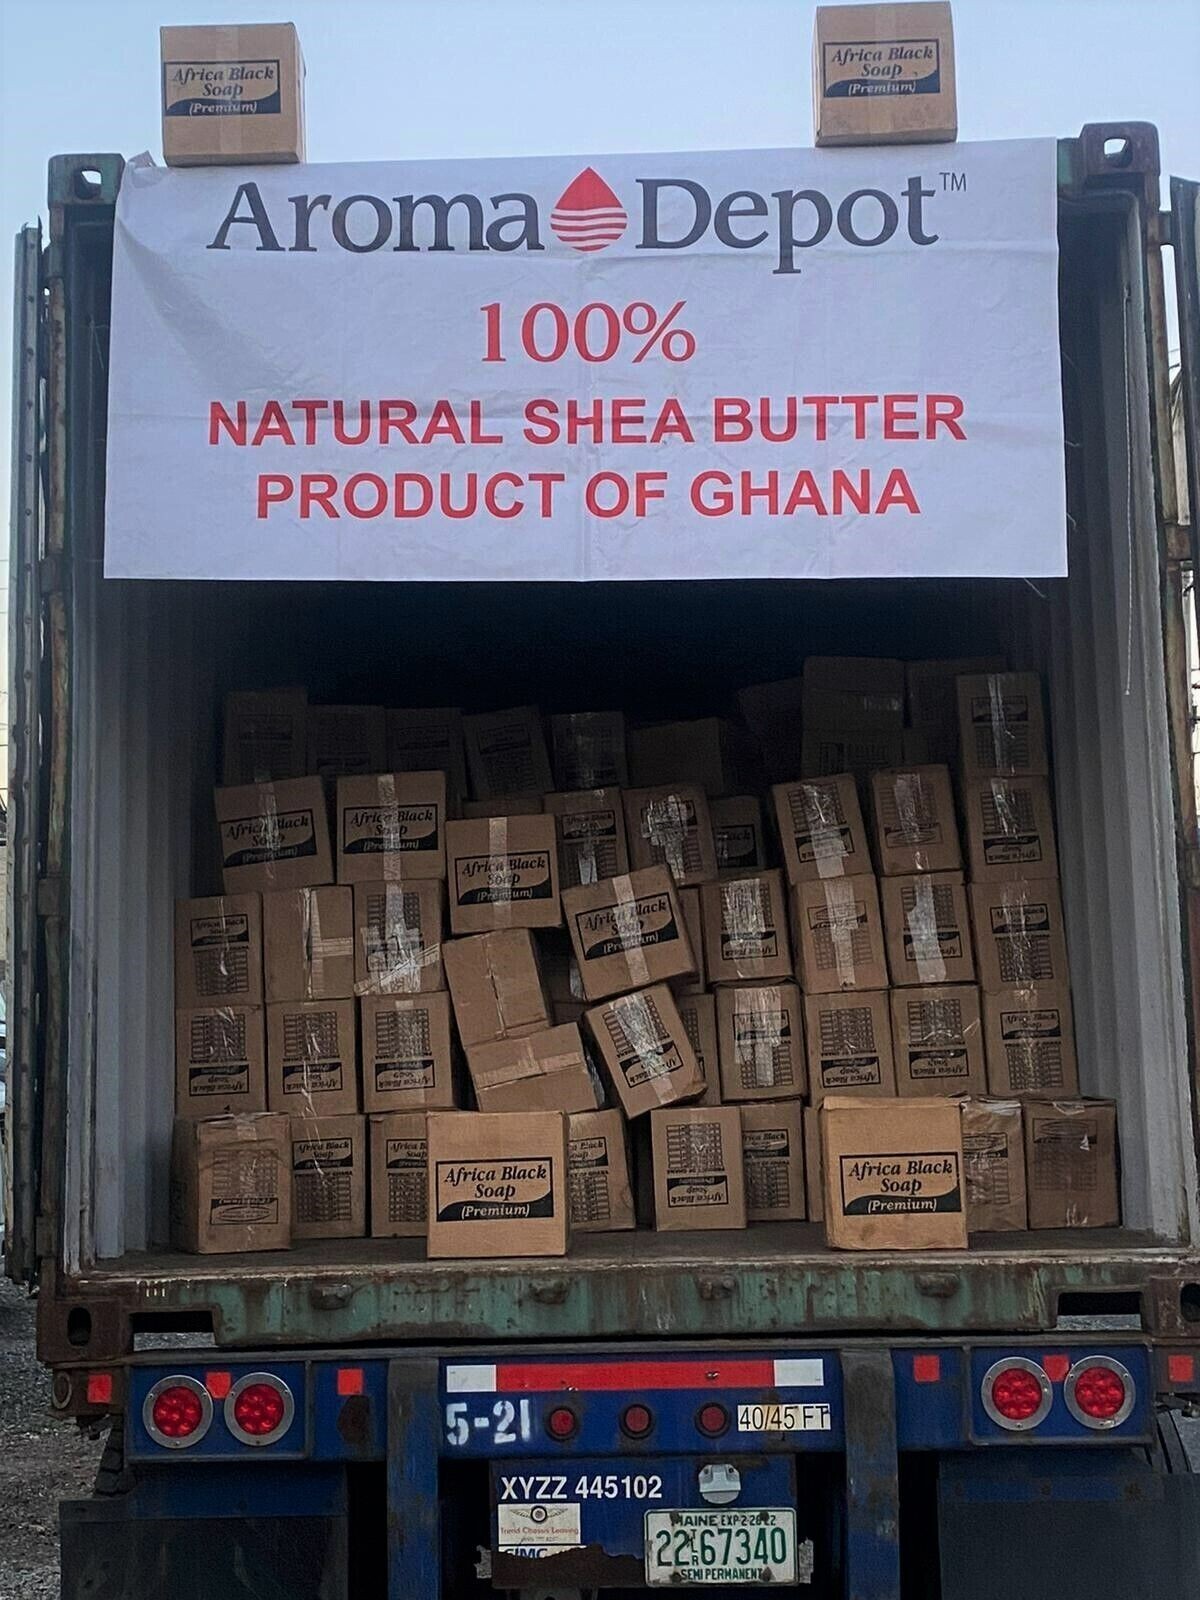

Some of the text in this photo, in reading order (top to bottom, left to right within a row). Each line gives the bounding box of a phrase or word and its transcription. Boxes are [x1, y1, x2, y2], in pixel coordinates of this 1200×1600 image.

[832, 46, 934, 66] Africa Black
[174, 66, 274, 85] Africa Black
[860, 63, 902, 79] Soap
[202, 83, 243, 98] Soap
[847, 81, 917, 96] (Premium)
[189, 101, 258, 114] (Premium)
[206, 171, 967, 274] Aroma Depot TM
[480, 300, 696, 363] 100%
[208, 394, 967, 446] NATURAL SHEA BUTTER
[257, 469, 921, 519] PRODUCT OF GHANA
[398, 810, 433, 822] Black
[509, 857, 545, 870] Black
[763, 1131, 786, 1139] Black
[325, 1140, 349, 1149] Black
[445, 1164, 547, 1187] Africa Black
[849, 1160, 952, 1181] Africa Black
[475, 1184, 516, 1201] Soap
[881, 1178, 922, 1195] Soap
[671, 1196, 695, 1204] Black
[868, 1198, 937, 1214] (Premium)
[461, 1204, 530, 1220] (Premium)
[446, 1399, 530, 1446] 5-21
[739, 1405, 829, 1431] 40/45 FT
[501, 1475, 662, 1500] XYZZ 445102
[656, 1529, 690, 1567] 22
[700, 1527, 787, 1566] 67340
[681, 1568, 762, 1580] SEMI PERMANENT
